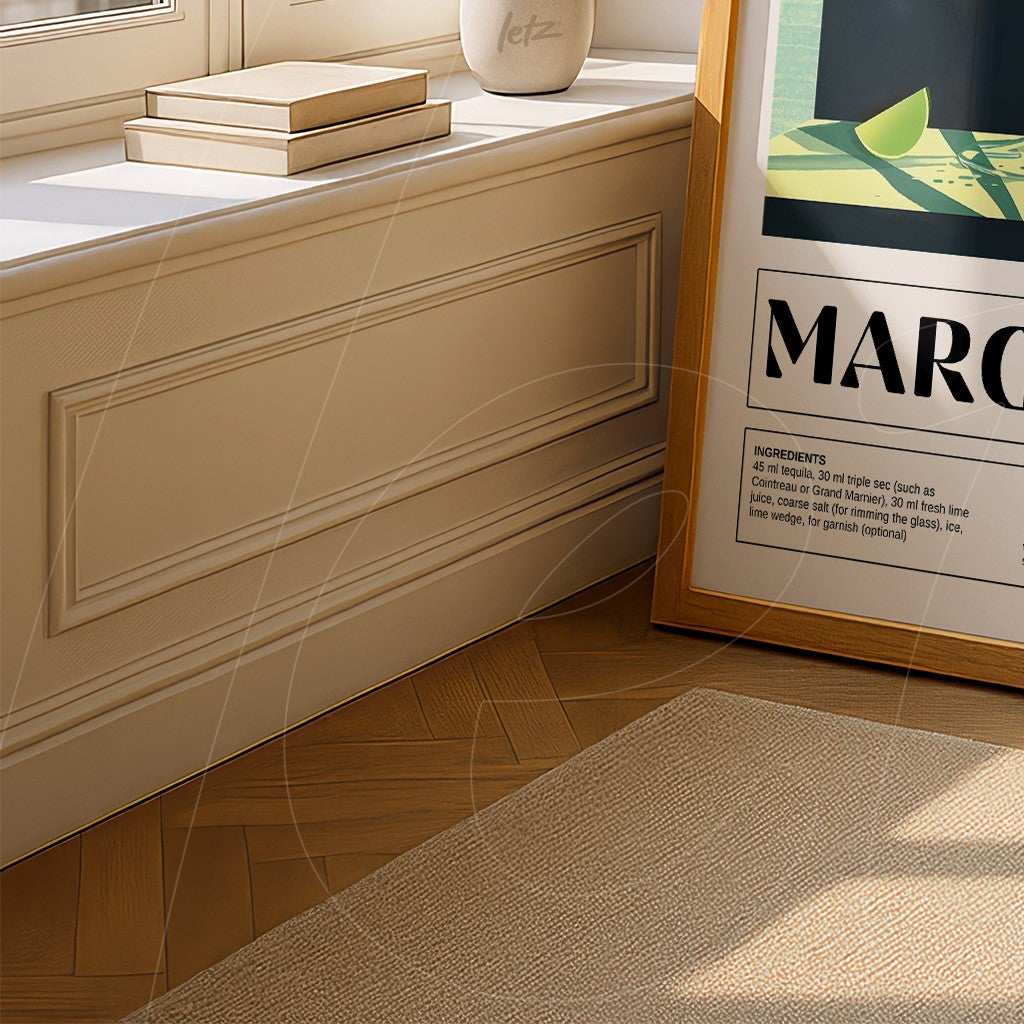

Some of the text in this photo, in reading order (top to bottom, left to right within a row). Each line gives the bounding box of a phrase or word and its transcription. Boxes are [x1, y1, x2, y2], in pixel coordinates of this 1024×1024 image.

[498, 12, 562, 52] letz
[753, 445, 827, 465] INGREDIENTS
[751, 475, 798, 492] Cointreau
[799, 484, 811, 494] or
[811, 484, 843, 499] Grand
[890, 495, 904, 508] 30
[906, 499, 919, 510] ml
[920, 499, 946, 514] fresh
[948, 504, 970, 518] lime
[752, 460, 766, 472] 45
[767, 462, 779, 474] ml
[817, 469, 831, 481] 30
[832, 472, 845, 483] ml
[847, 474, 871, 487] triple
[873, 479, 891, 490] sec
[893, 480, 921, 494] (such
[922, 486, 936, 497] as
[748, 505, 907, 542] lime wedge, for garnish (optional)
[777, 496, 810, 509] coarse
[811, 501, 830, 513] salt
[831, 502, 849, 516] (for
[850, 505, 890, 524] rimming
[891, 511, 908, 525] the
[945, 519, 963, 535] ice,
